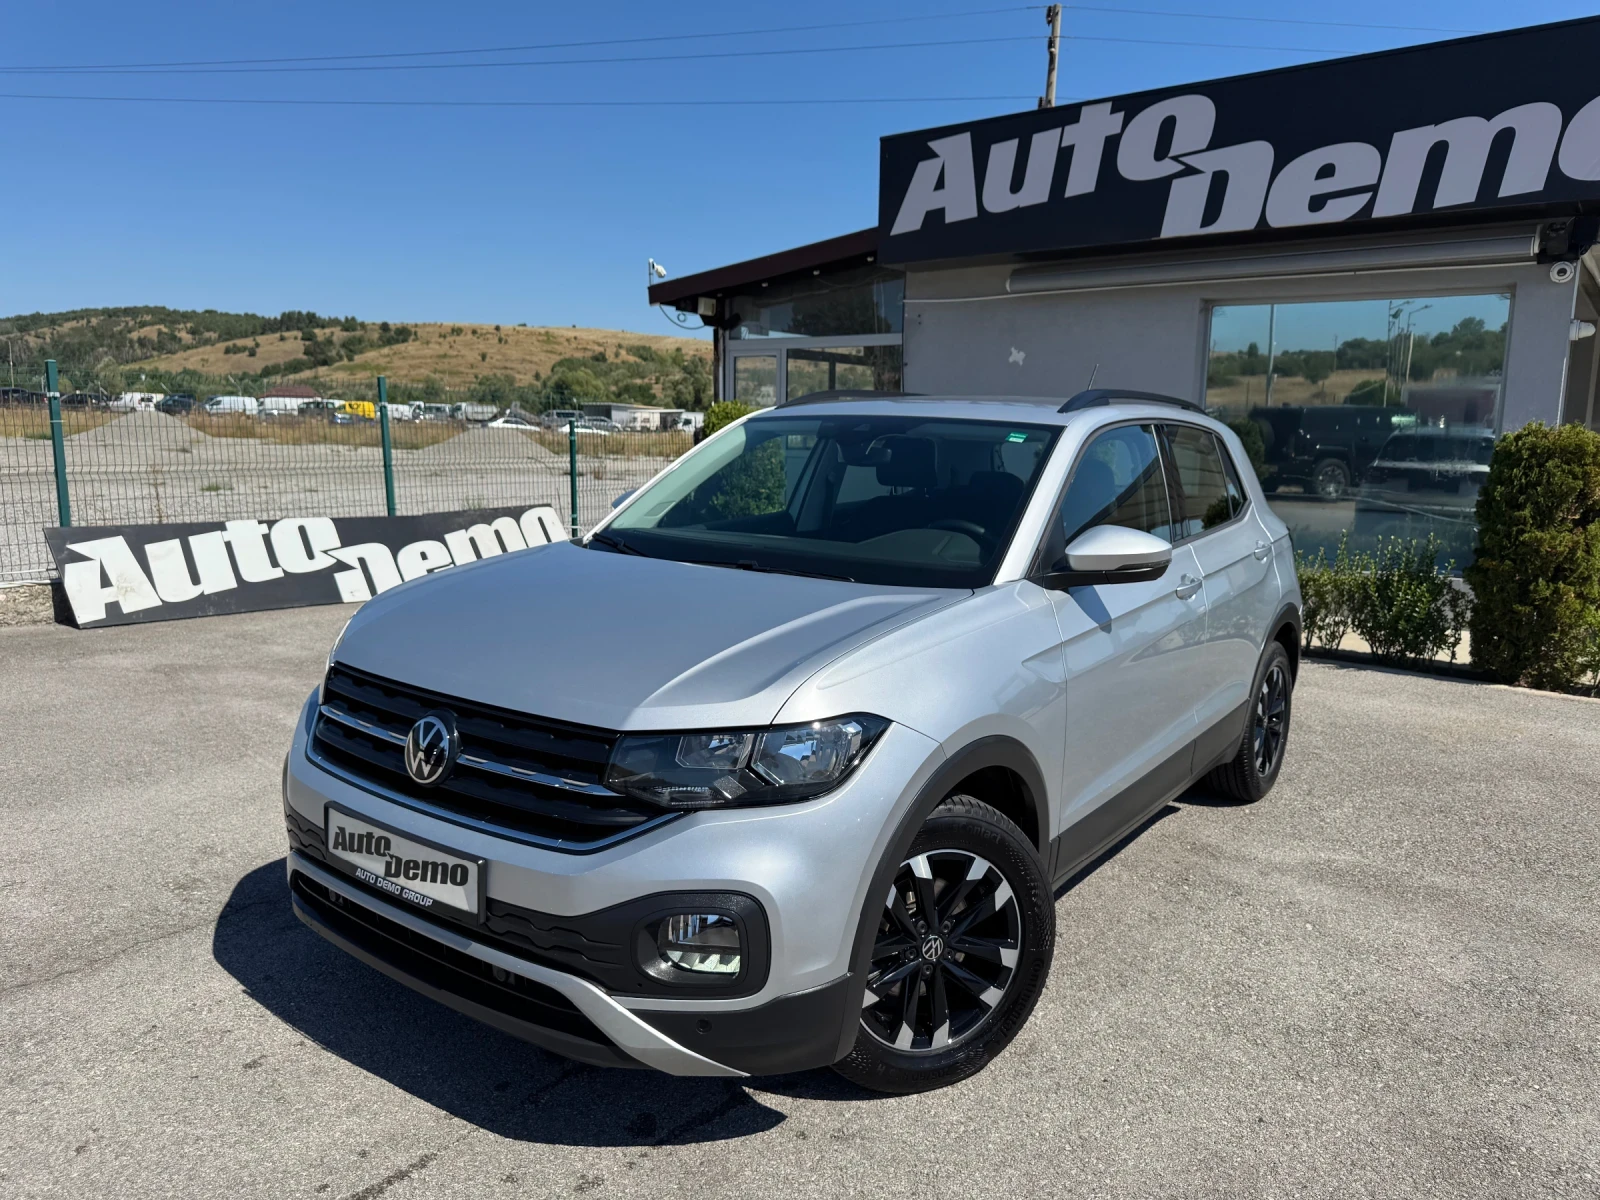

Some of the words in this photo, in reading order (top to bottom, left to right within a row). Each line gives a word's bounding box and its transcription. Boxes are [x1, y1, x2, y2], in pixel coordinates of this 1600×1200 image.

[890, 95, 1216, 236] Auto
[64, 517, 341, 624] Auto
[333, 826, 391, 857] Auto
[355, 868, 376, 884] AUTO
[376, 877, 401, 895] DEMO
[402, 889, 434, 907] GROUP
[384, 852, 469, 887] Demo
